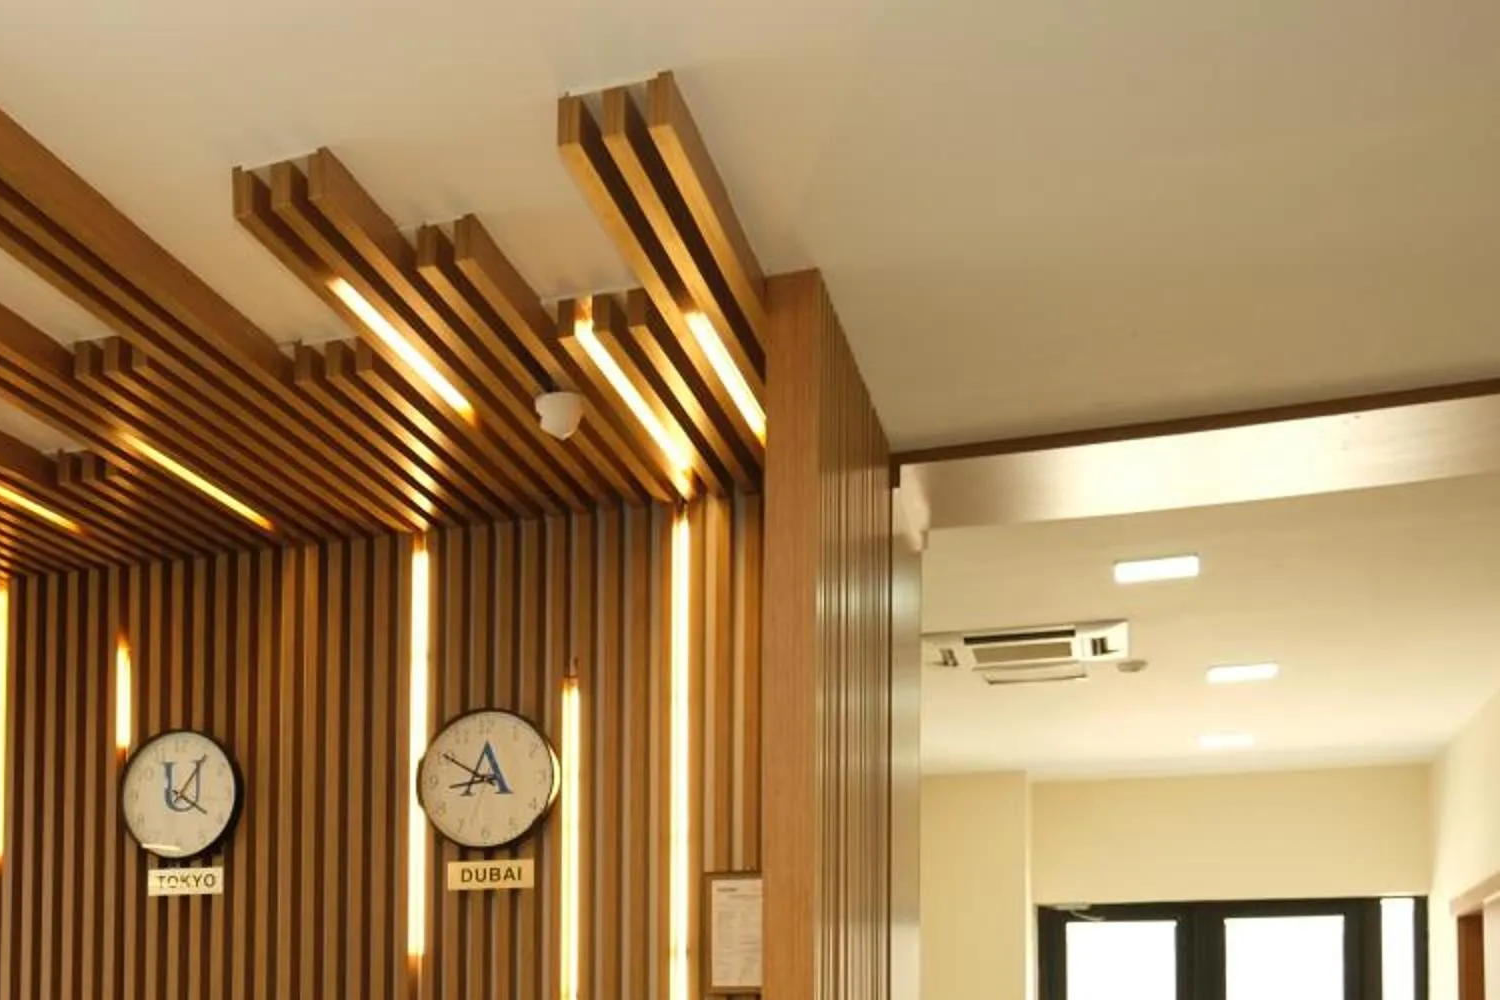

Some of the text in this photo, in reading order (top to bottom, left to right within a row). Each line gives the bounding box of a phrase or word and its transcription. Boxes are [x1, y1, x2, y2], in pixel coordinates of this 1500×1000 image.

[459, 739, 514, 797] A
[161, 760, 204, 813] U
[156, 873, 216, 889] TOKYO
[461, 866, 522, 883] DUBAI
